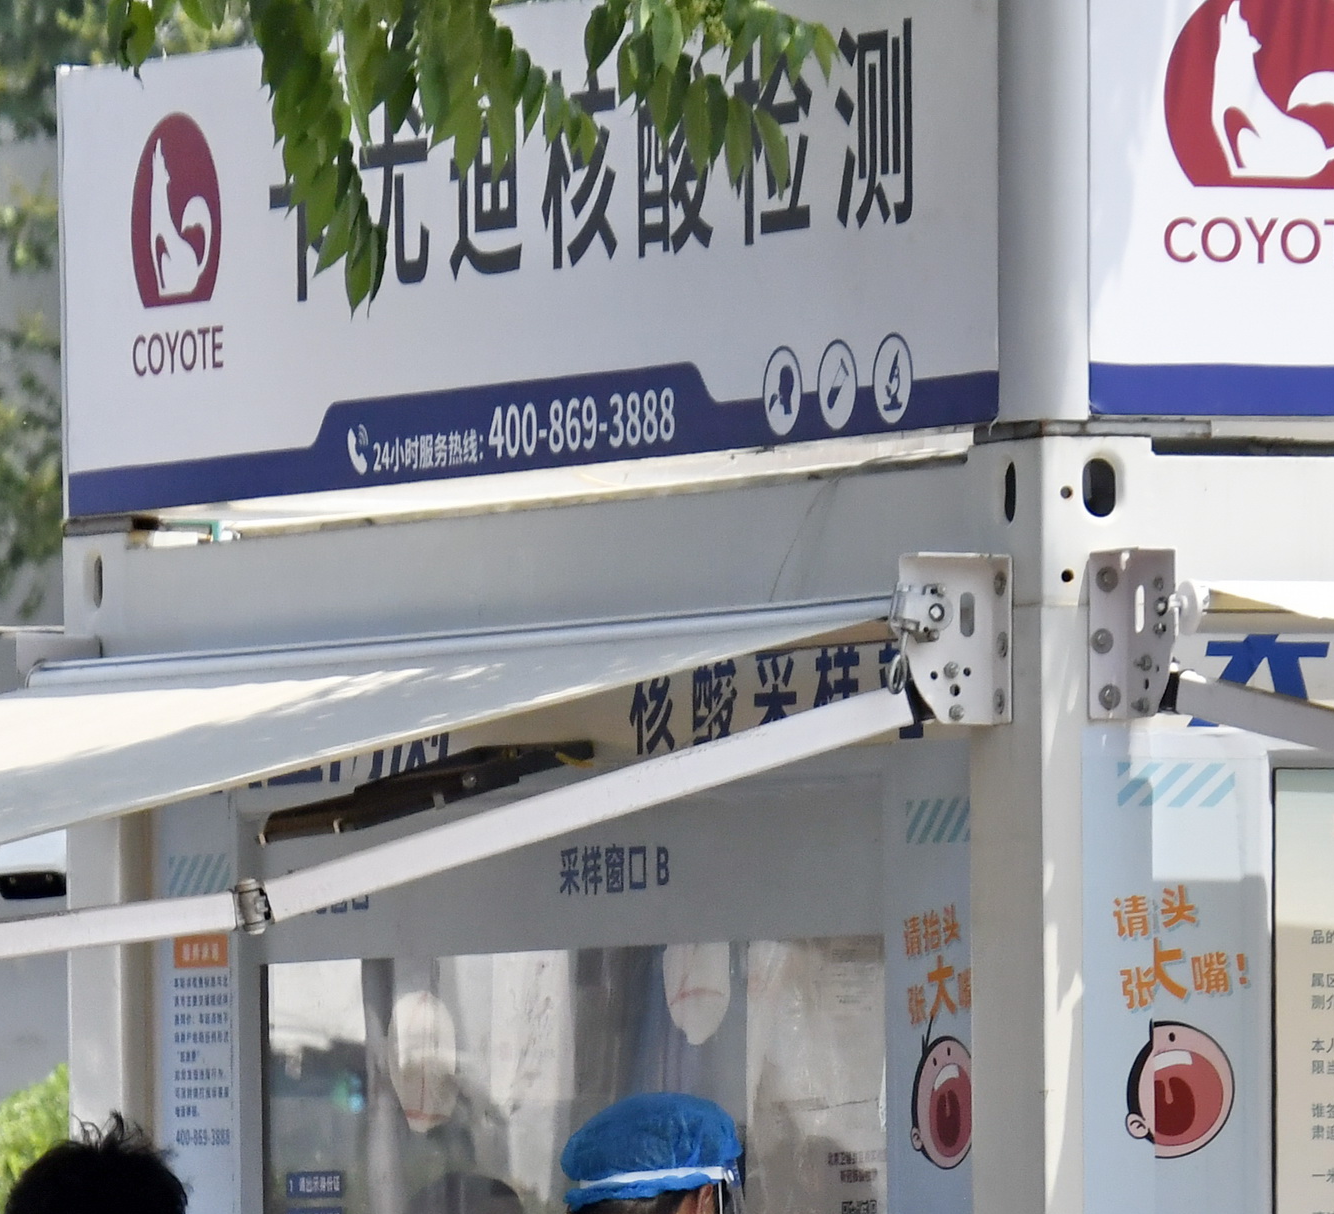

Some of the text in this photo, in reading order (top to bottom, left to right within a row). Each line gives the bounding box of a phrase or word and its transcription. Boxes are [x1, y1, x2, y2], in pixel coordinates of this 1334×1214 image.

[132, 325, 224, 377] COYOTE
[488, 387, 677, 459] 400-869-3888
[629, 641, 924, 756] 核酸采样
[559, 844, 670, 896] 采样窗口 B
[903, 903, 960, 955] 请抬头
